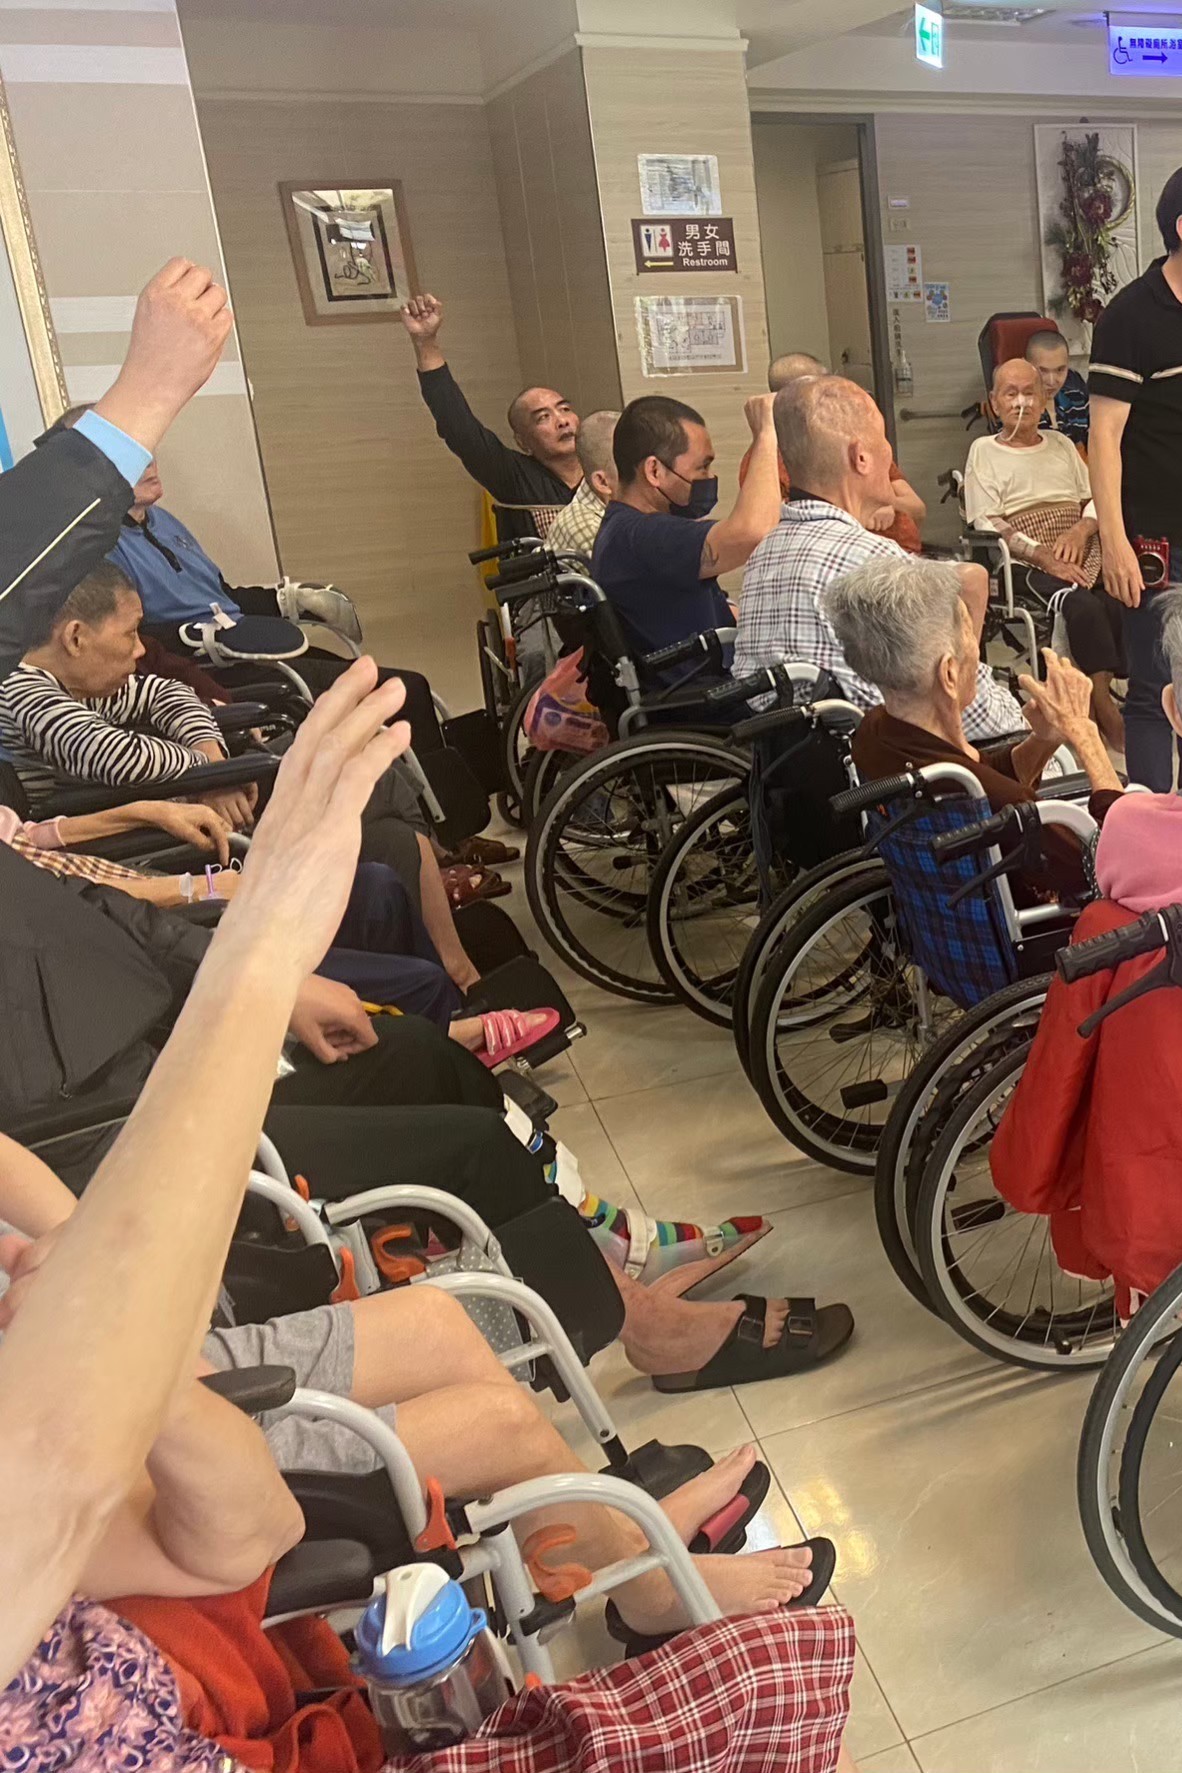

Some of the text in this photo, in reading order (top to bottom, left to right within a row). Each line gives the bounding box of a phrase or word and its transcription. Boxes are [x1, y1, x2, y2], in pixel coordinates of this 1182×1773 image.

[685, 224, 719, 240] 男女
[678, 241, 730, 256] 洗手間
[683, 258, 728, 267] Restroom
